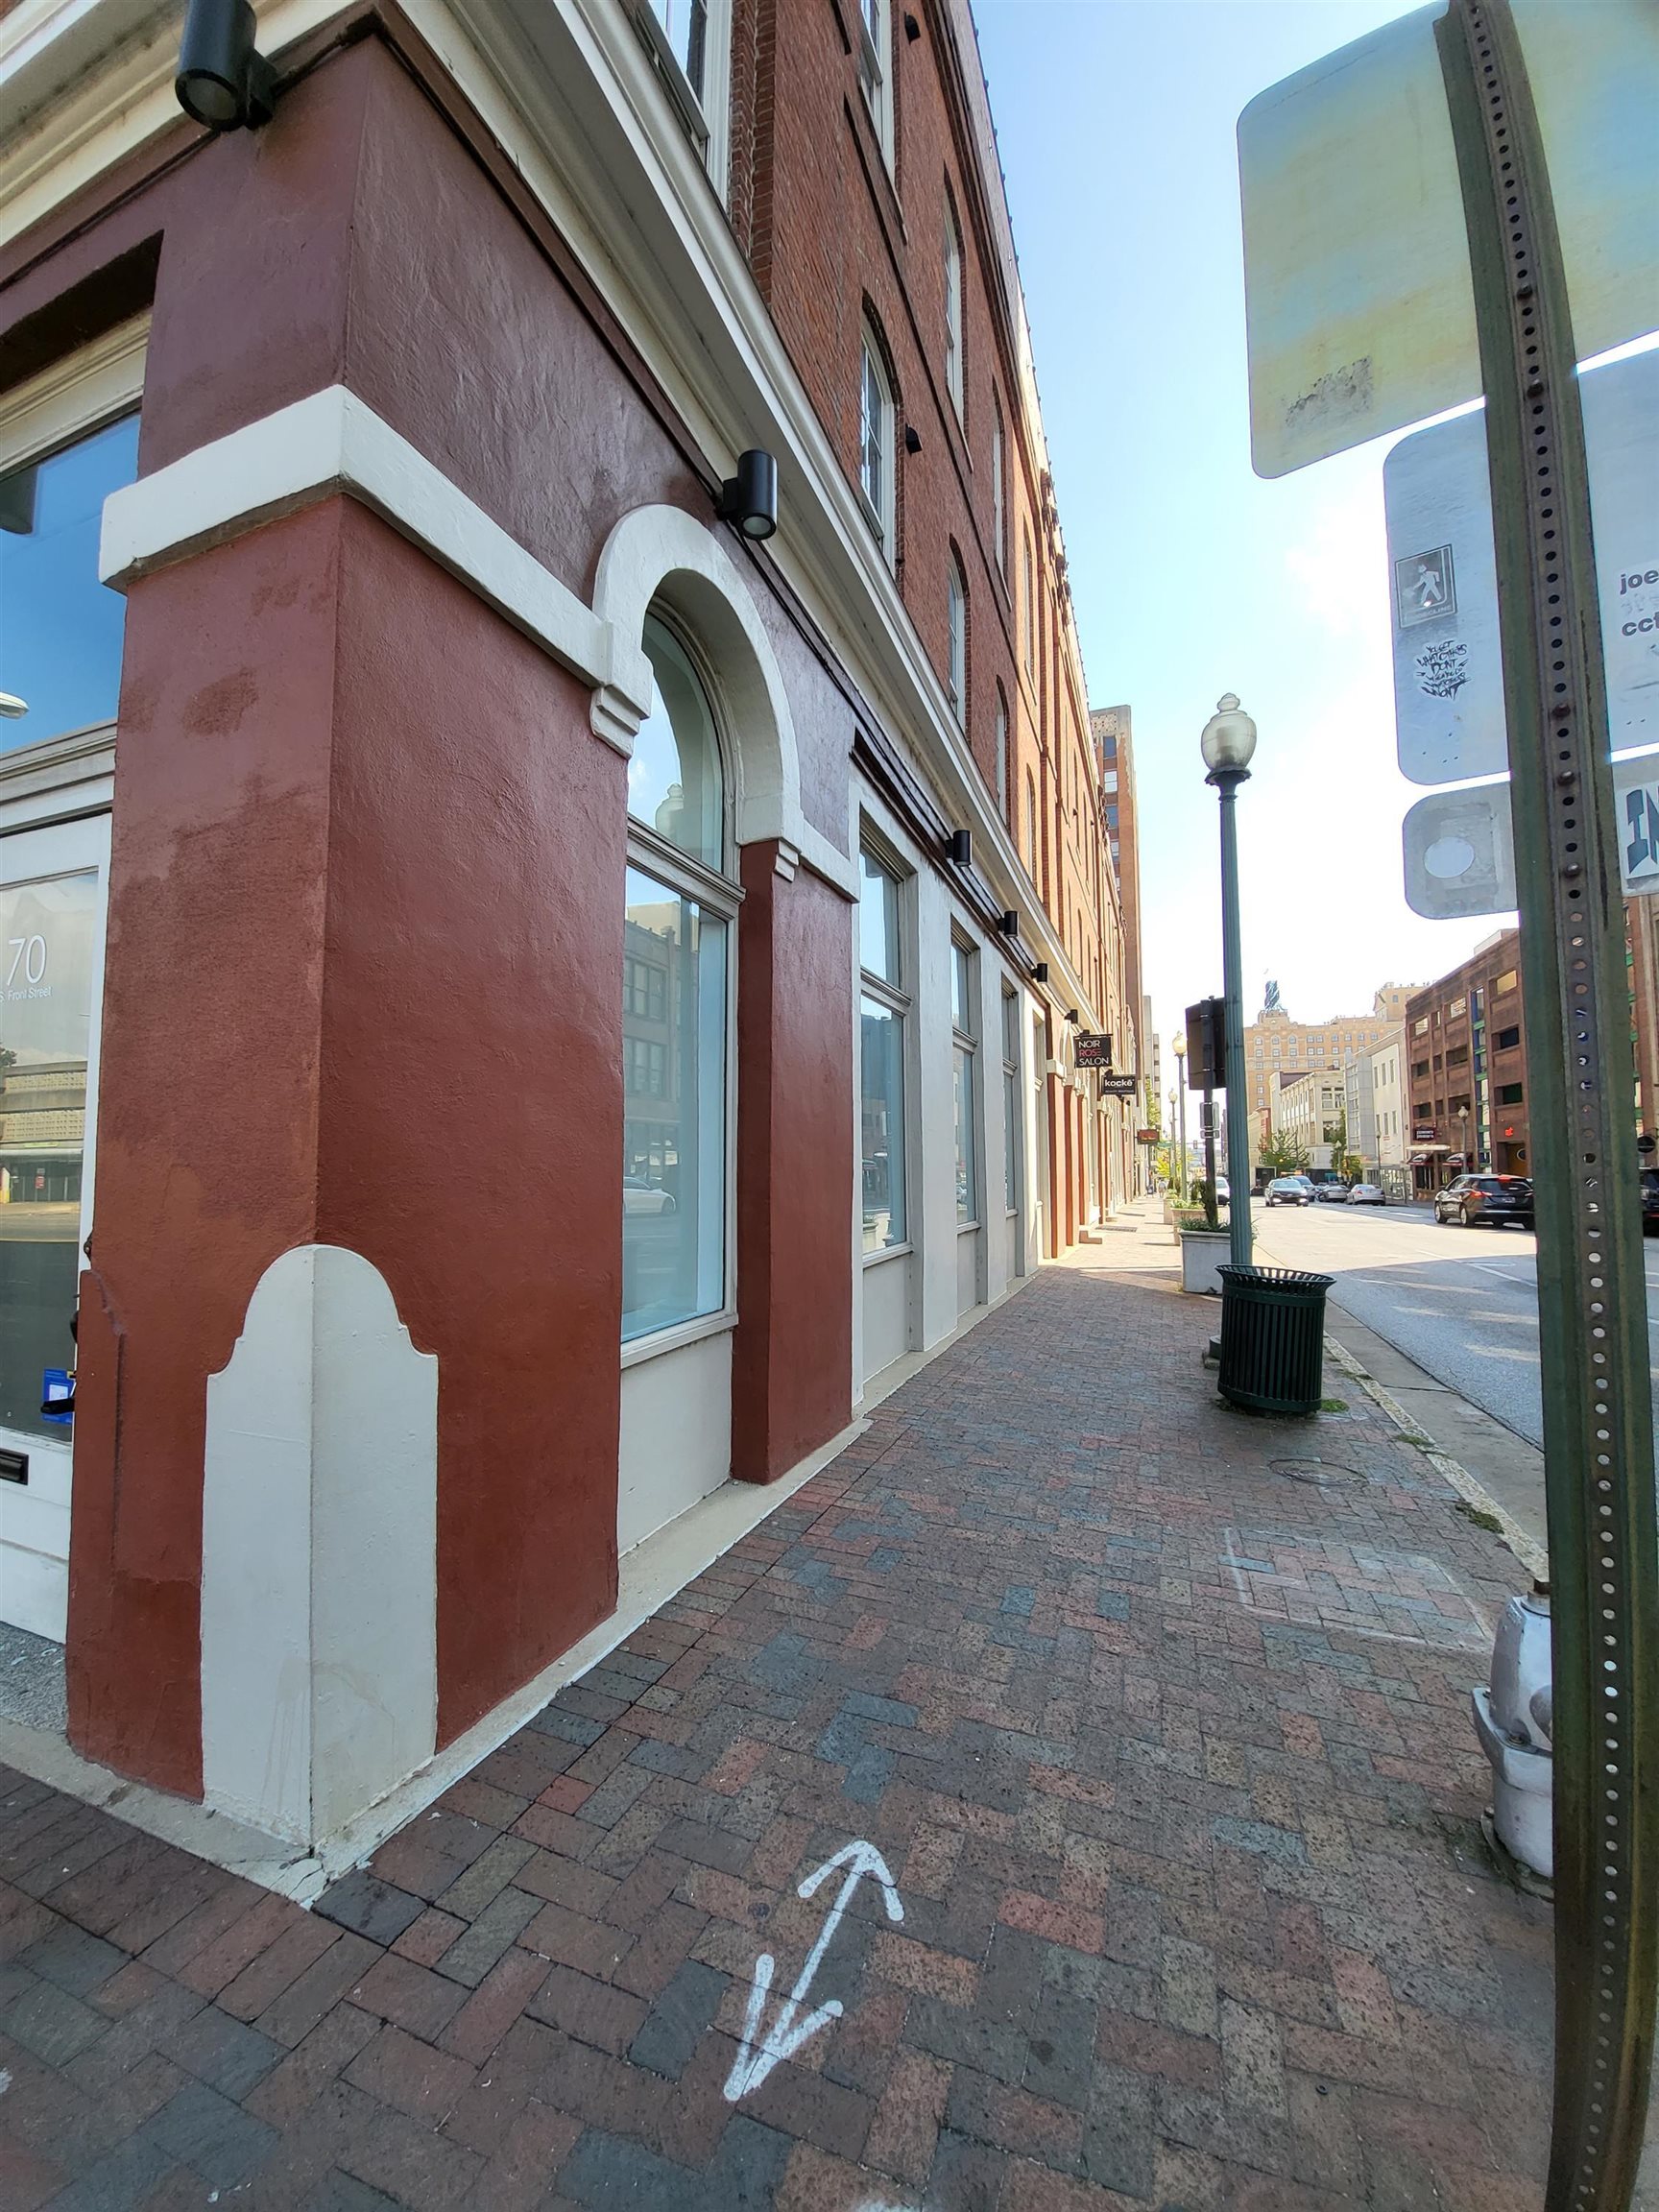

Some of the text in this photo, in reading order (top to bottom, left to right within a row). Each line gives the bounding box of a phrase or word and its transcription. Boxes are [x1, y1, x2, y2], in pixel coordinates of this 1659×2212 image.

[7, 934, 48, 986] 70
[8, 989, 28, 1001] Front
[28, 986, 52, 998] Street
[1078, 1040, 1101, 1048] NOIR
[1078, 1047, 1103, 1057] ROSE
[1078, 1057, 1110, 1066] SALON
